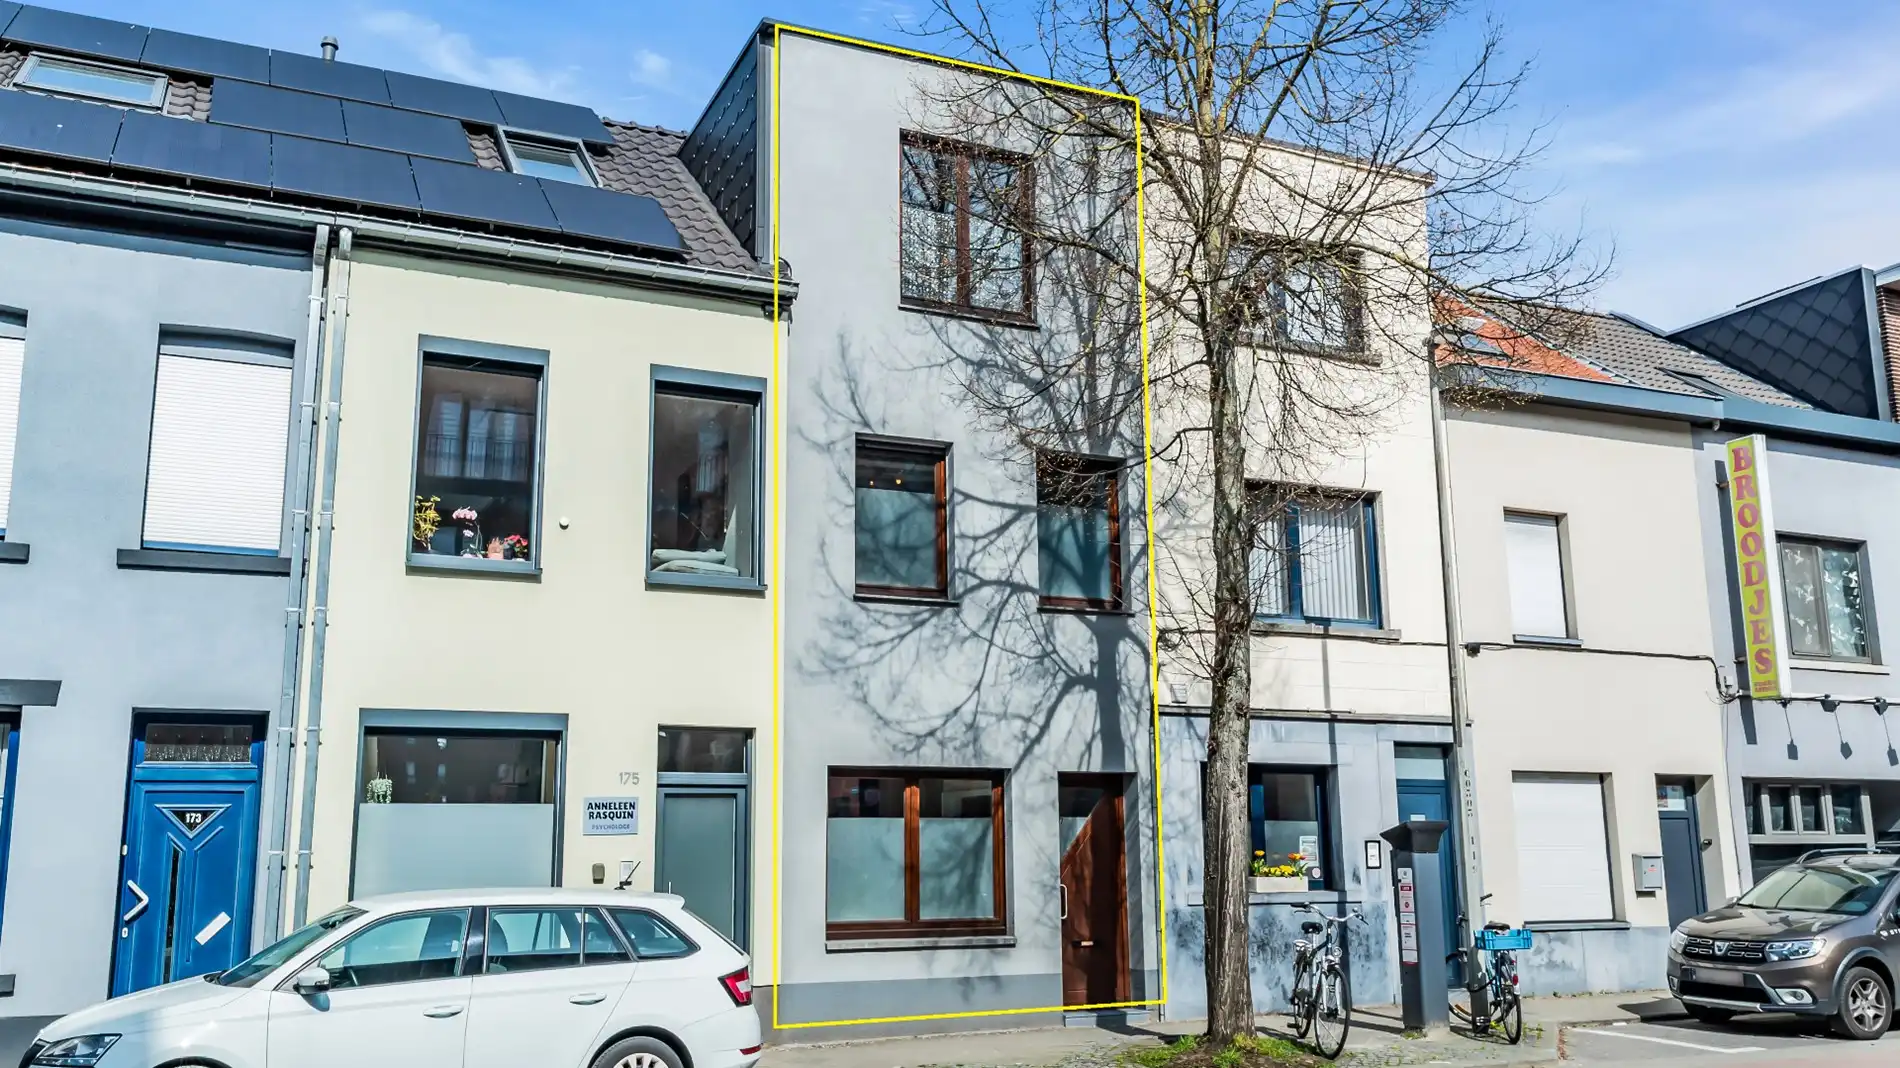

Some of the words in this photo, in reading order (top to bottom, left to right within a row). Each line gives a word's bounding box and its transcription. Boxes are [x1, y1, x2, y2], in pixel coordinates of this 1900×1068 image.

[1731, 446, 1773, 675] BROODJES
[619, 771, 640, 785] 175
[587, 801, 636, 811] ANNELEEN
[185, 812, 202, 823] 173
[588, 811, 634, 821] RASQUIN
